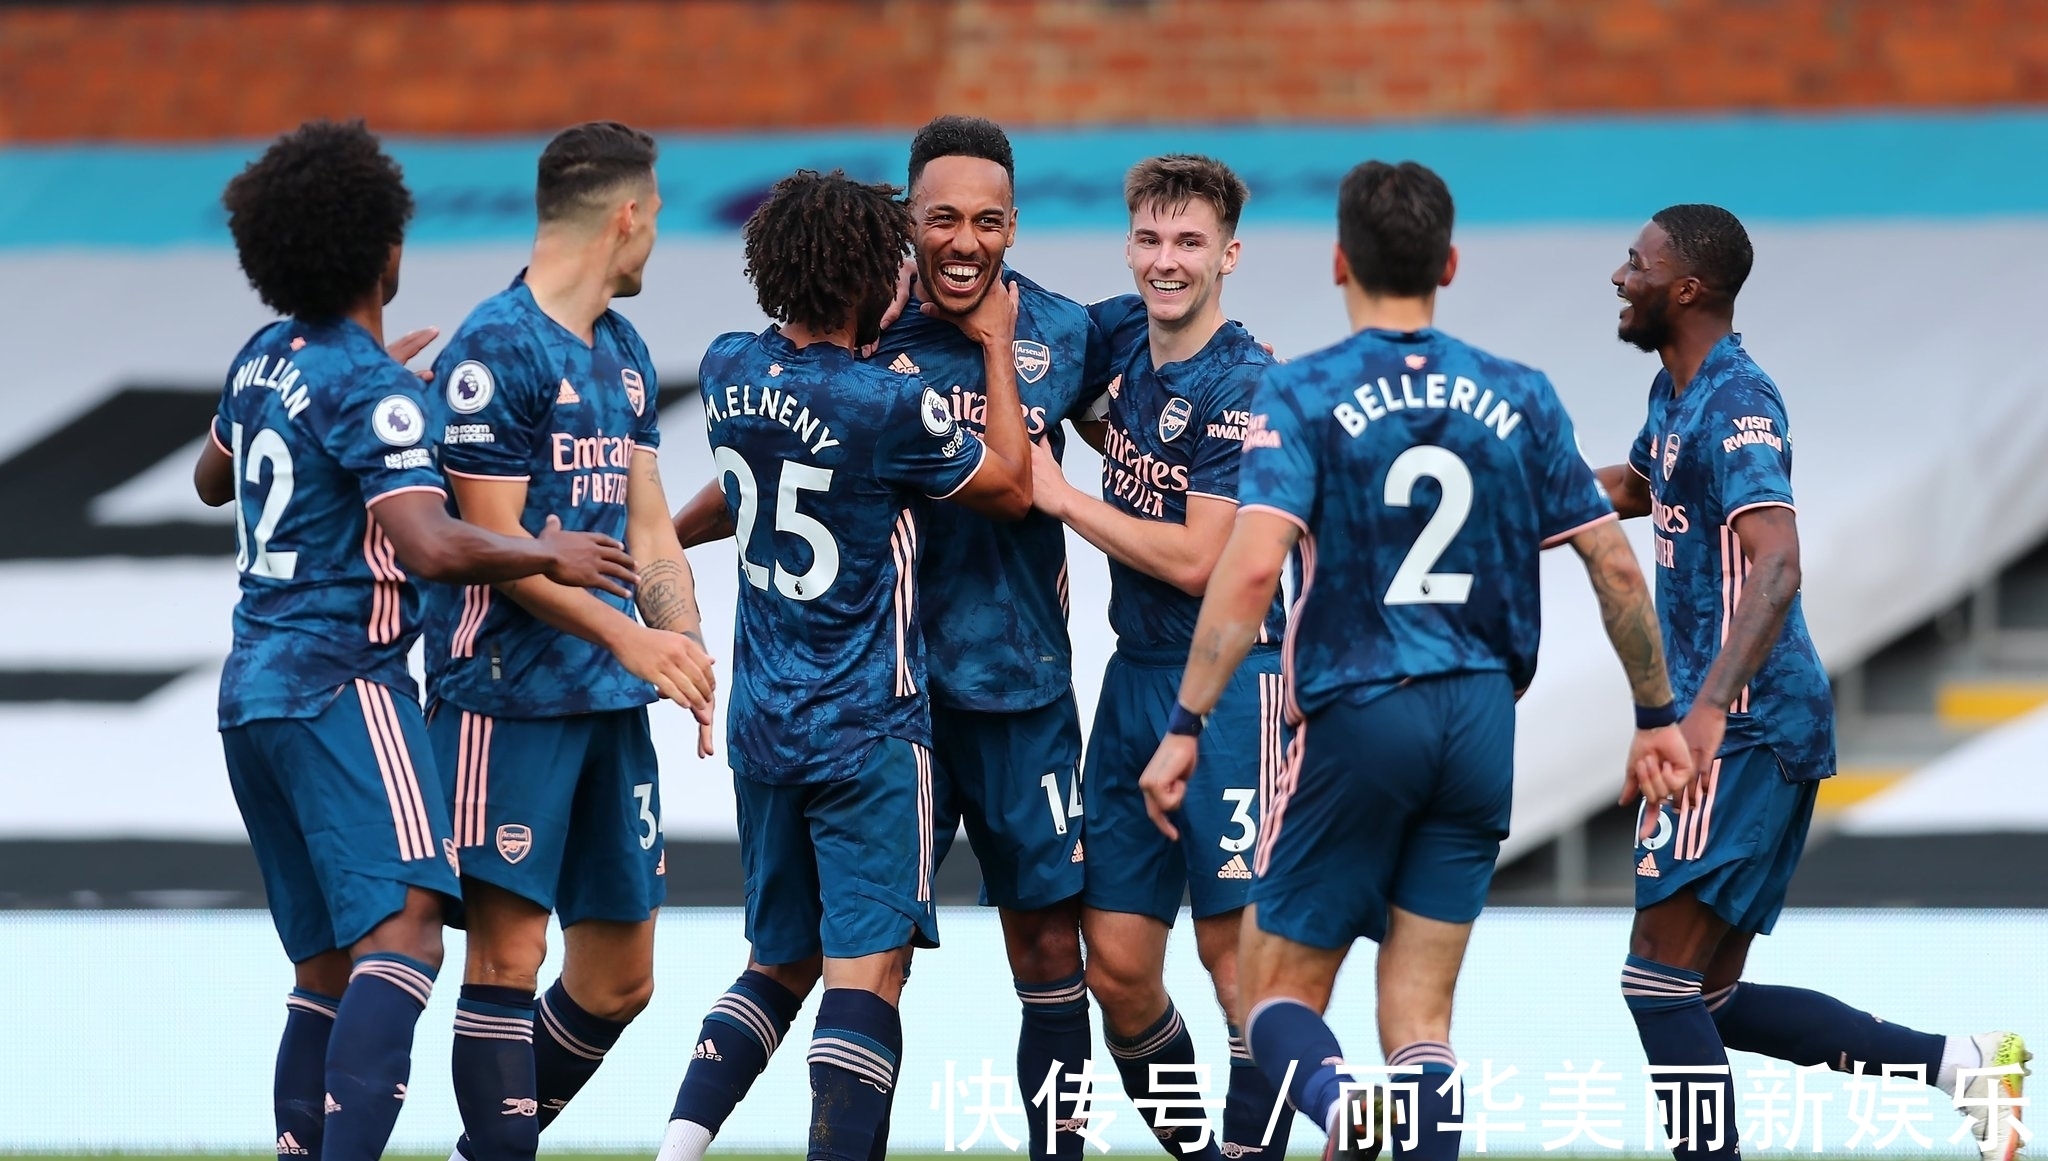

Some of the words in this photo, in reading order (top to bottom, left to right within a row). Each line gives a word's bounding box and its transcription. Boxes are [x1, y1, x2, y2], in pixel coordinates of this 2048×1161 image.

[1017, 346, 1044, 357] Arsenal
[232, 354, 311, 421] WILLIAN
[706, 384, 840, 455] M.ELNENY
[1332, 373, 1521, 440] BELLERIN
[459, 424, 491, 434] room
[1722, 430, 1783, 453] RWANDA
[1732, 415, 1773, 432] VISIT
[231, 421, 299, 581] 12
[714, 445, 841, 601] 25
[1383, 444, 1475, 606] 2
[633, 782, 664, 851] 3
[1219, 788, 1257, 852] 3
[1217, 869, 1253, 879] adidas
